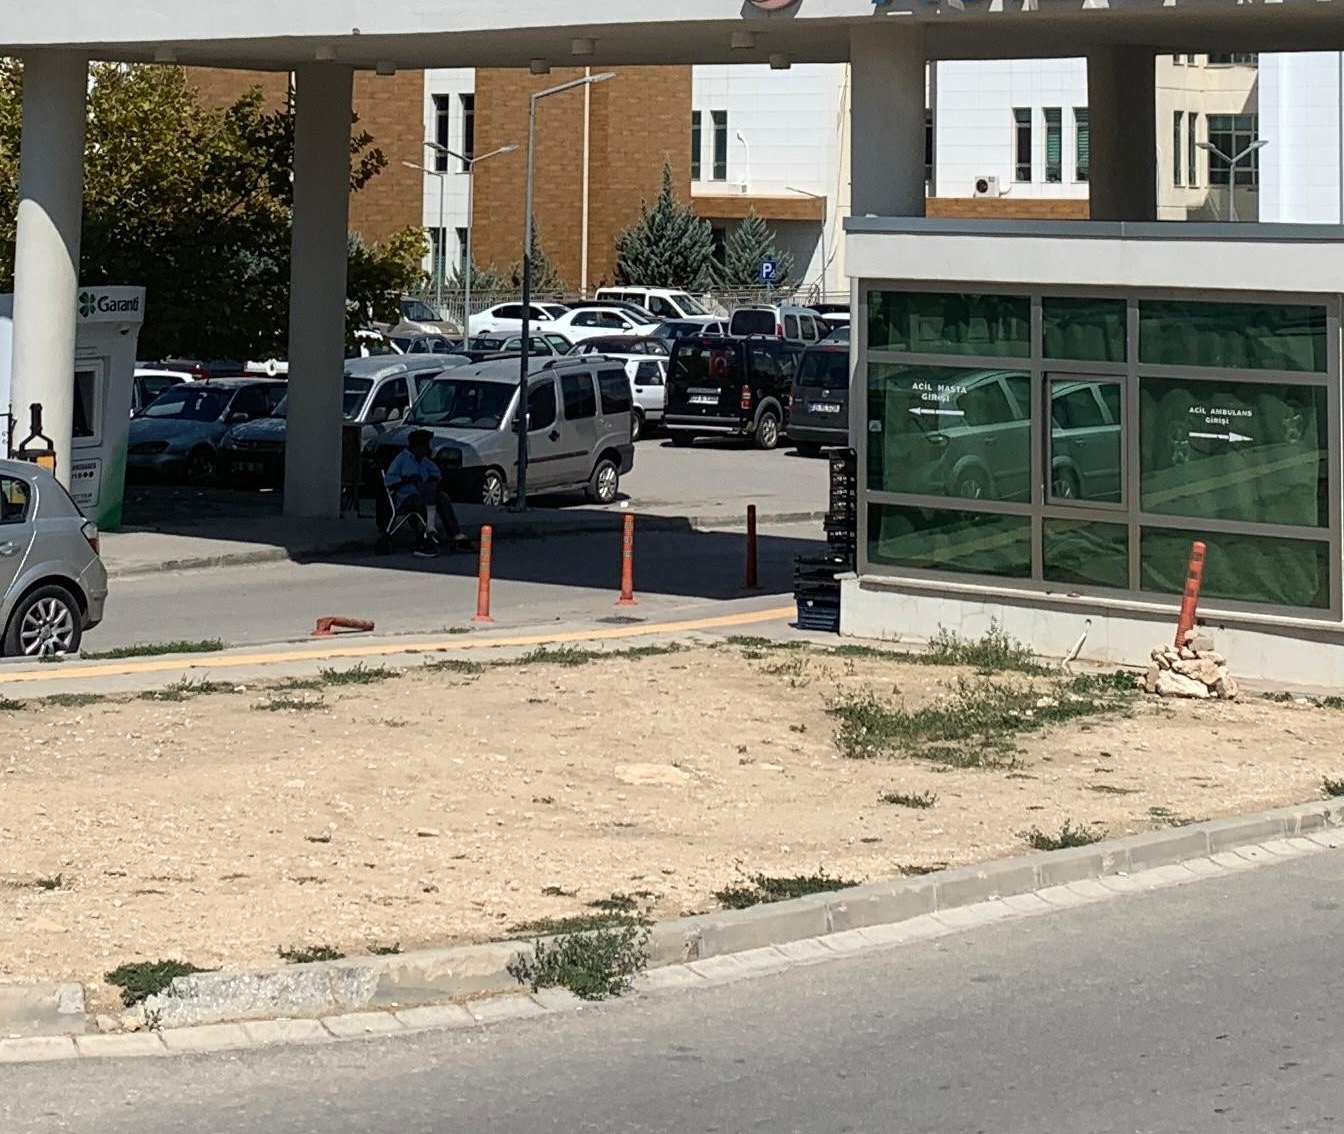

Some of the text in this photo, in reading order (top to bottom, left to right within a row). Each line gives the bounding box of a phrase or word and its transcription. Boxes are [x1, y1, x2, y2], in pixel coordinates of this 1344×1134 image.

[762, 262, 772, 279] P
[97, 295, 139, 312] Garanti
[912, 381, 967, 394] ACİL HASTA
[1188, 406, 1253, 417] ACİL AMBULANS
